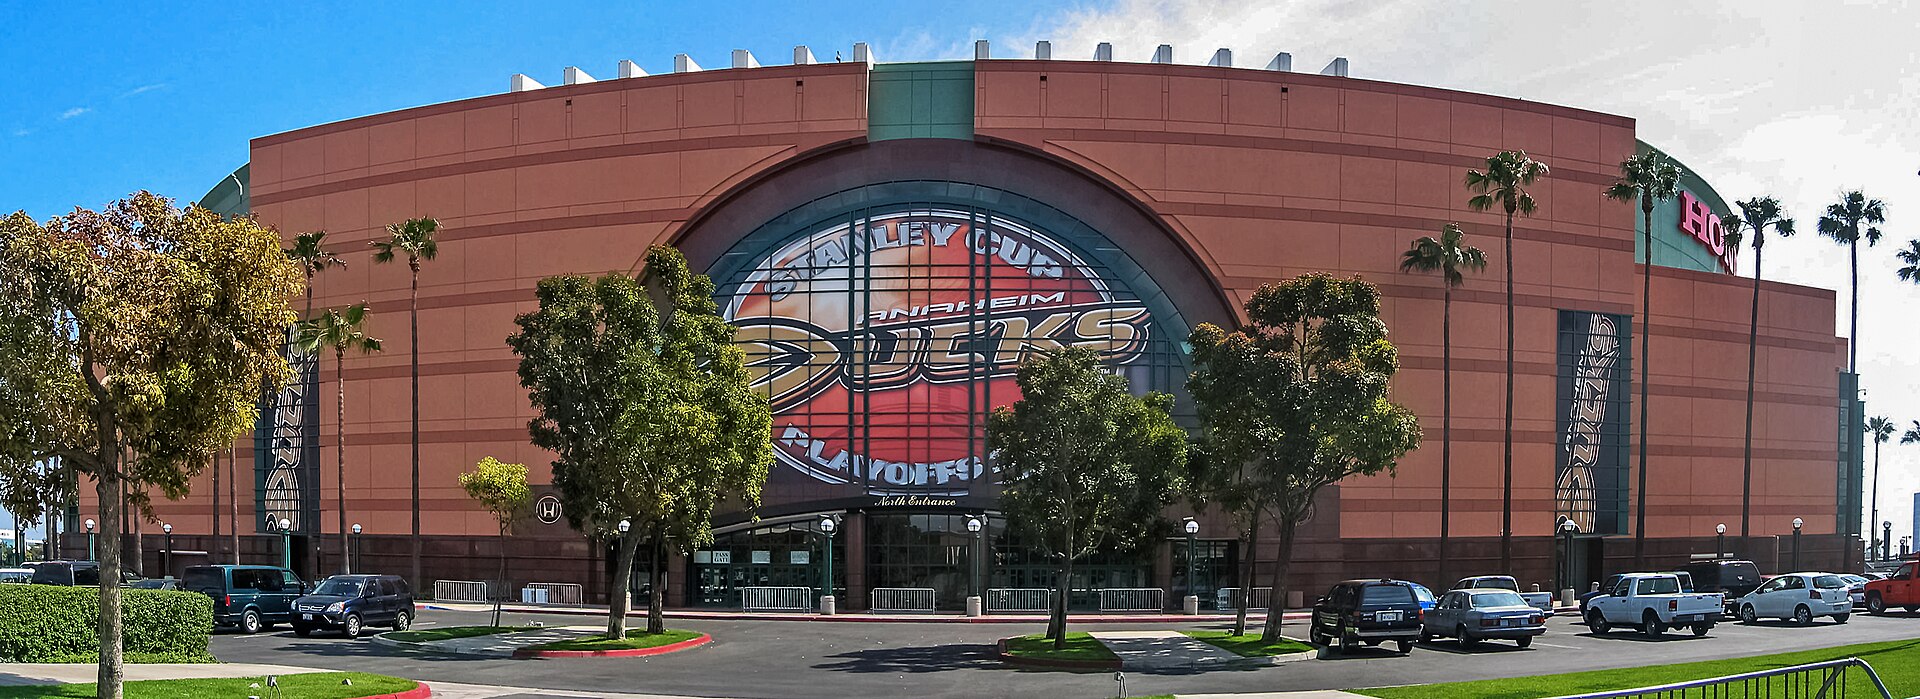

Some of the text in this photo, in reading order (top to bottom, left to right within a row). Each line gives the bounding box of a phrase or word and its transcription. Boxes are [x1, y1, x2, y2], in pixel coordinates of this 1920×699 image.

[764, 222, 1064, 302] STANLEY CUP
[857, 291, 1066, 326] ANAHEIM
[733, 306, 1152, 413] DUCKS
[779, 422, 984, 487] PLAYOFFS
[1555, 313, 1620, 534] DUCKS
[874, 495, 957, 507] North Entrance
